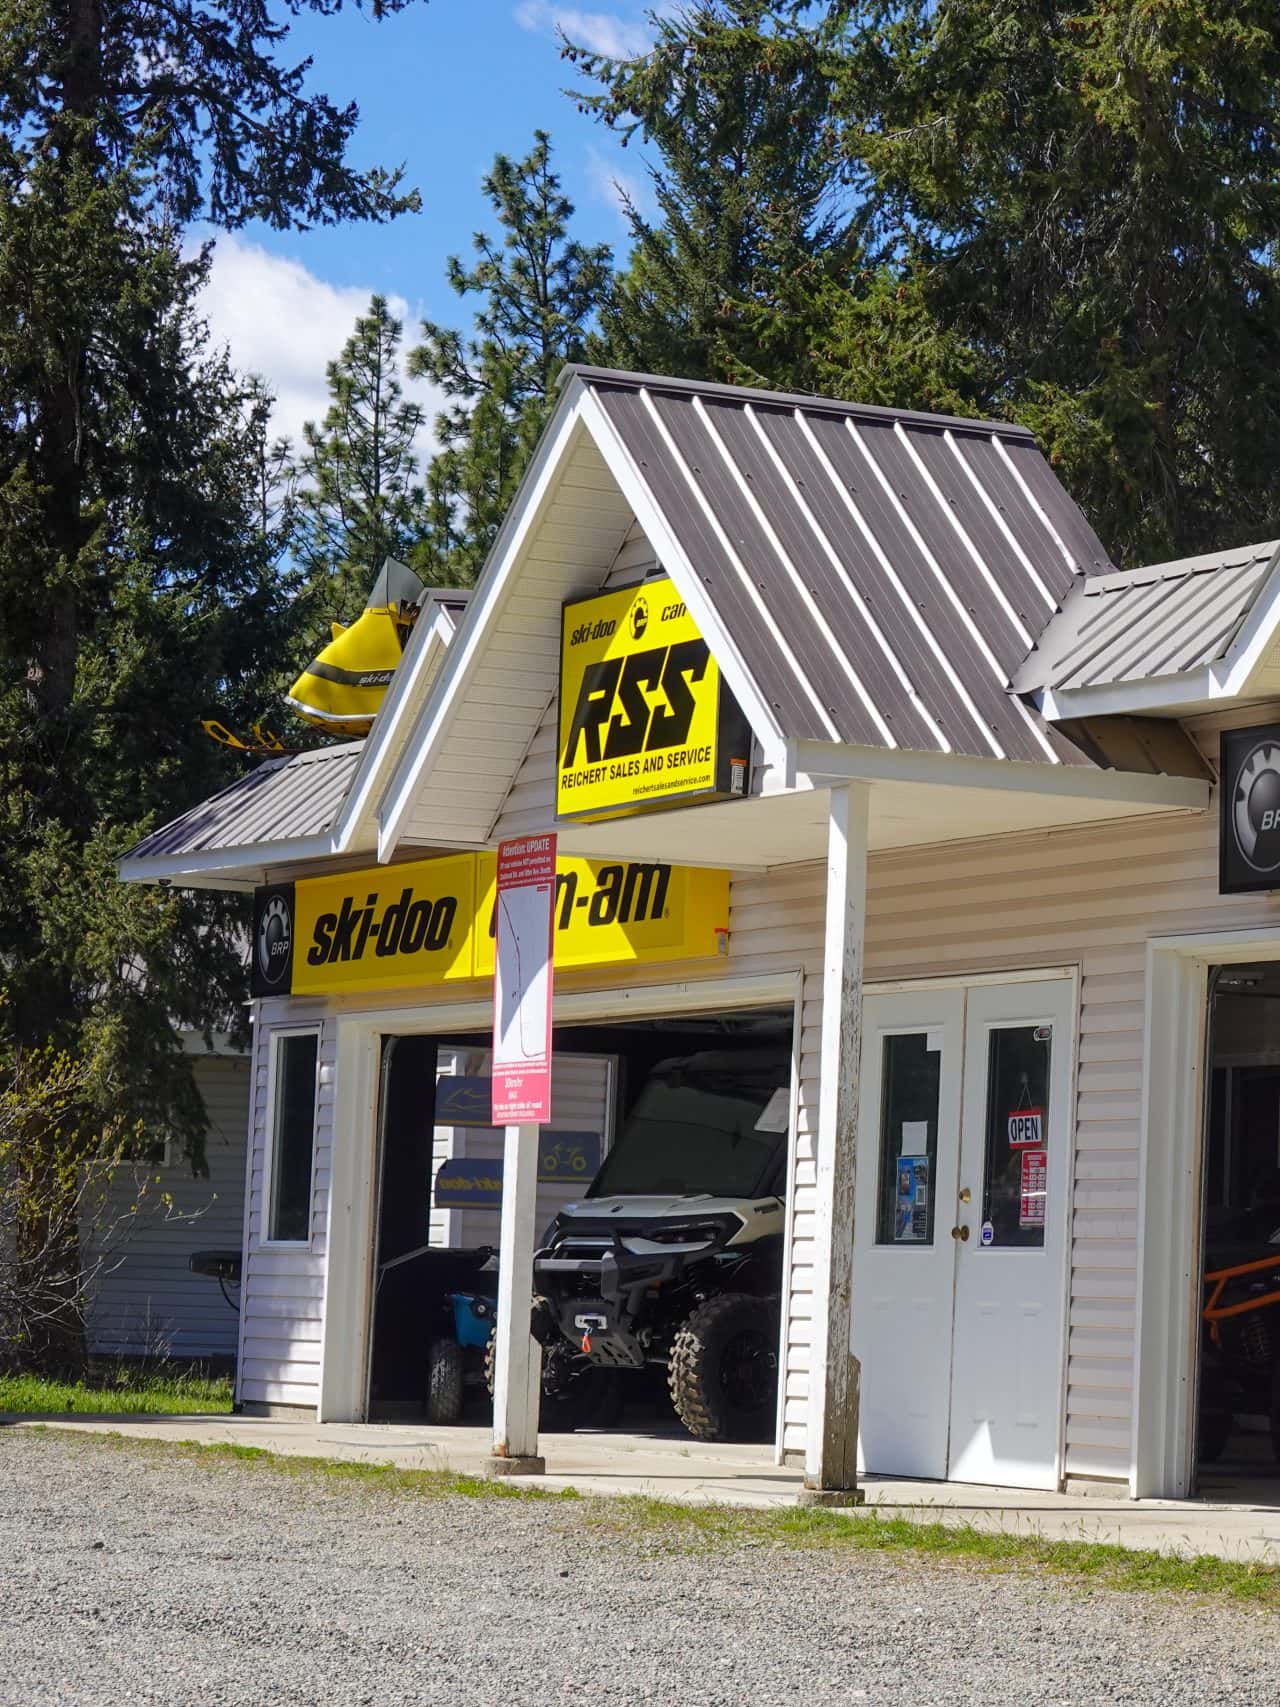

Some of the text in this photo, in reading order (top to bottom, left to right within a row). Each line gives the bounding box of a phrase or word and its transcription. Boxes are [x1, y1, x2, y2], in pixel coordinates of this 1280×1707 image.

[570, 618, 616, 646] ski-doo
[562, 638, 711, 769] RSS
[561, 746, 711, 790] REICHERT SALES AND SERVICE
[632, 774, 711, 796] reichertsalesandservice.com
[526, 838, 550, 853] UPDATE
[307, 888, 457, 966] ski-doo
[271, 940, 289, 956] BRP
[1010, 1116, 1040, 1142] OPEN
